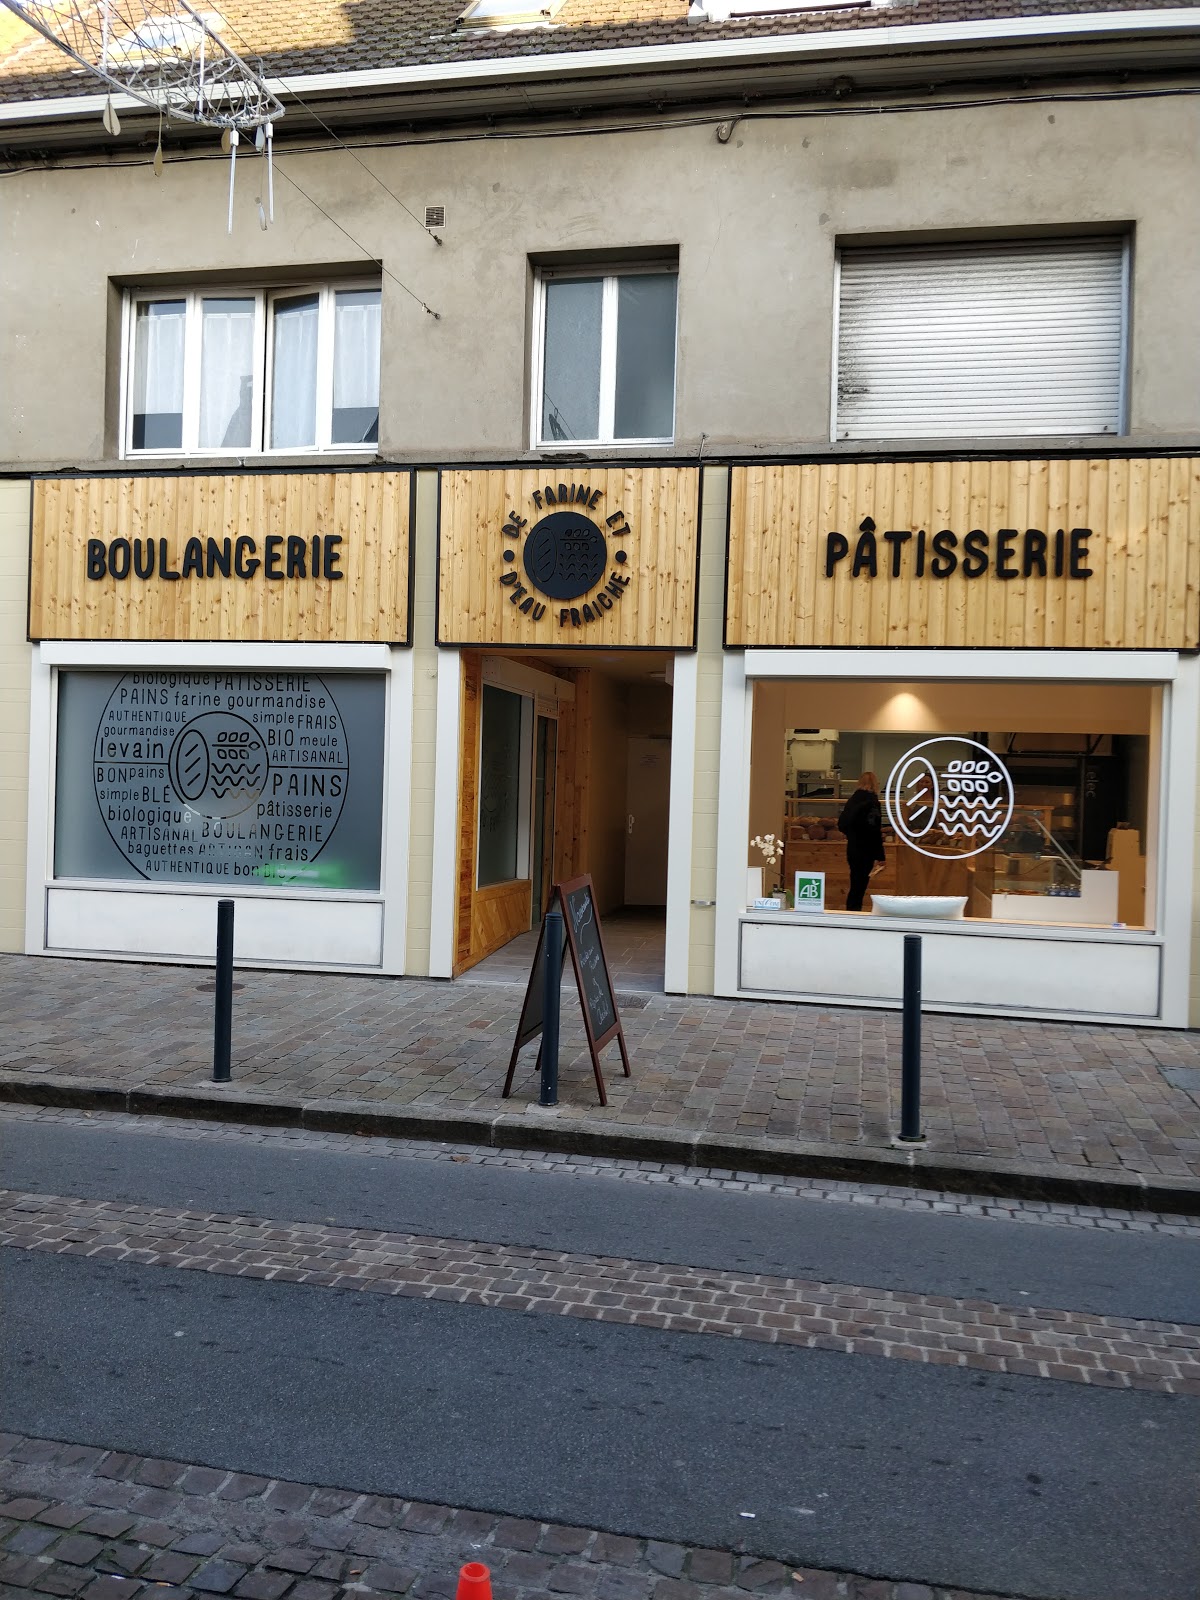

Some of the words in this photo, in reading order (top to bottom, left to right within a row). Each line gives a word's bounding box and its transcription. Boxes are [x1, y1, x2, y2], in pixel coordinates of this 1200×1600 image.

[501, 510, 528, 539] DE
[532, 483, 603, 510] FARINE
[605, 510, 631, 536] ET
[826, 516, 1093, 578] PÂTISSERIE
[87, 535, 344, 580] BOULANGERIE
[500, 571, 547, 621] D'EAU
[559, 571, 631, 628] FRAICHE
[120, 688, 168, 705] PAINS
[174, 691, 221, 706] farine
[228, 694, 326, 710] gourmandise
[108, 710, 187, 723] AUTHENTIQUE
[252, 711, 294, 725] simple
[297, 714, 337, 729] FRAIS
[104, 726, 175, 737] gourmandise
[268, 729, 294, 746] BIO
[300, 735, 338, 746] meule
[100, 737, 164, 758] levain
[272, 749, 343, 764] ARTISANAL
[97, 767, 127, 783] BON
[129, 765, 165, 780] pains
[100, 788, 139, 802] simple
[142, 785, 171, 803] BLÉ
[272, 773, 342, 797] PAINS
[108, 805, 192, 826] biologique
[256, 800, 333, 819] pâtisserie
[120, 826, 199, 843] ARTISANAL
[201, 821, 323, 842] BOULANGERIE
[128, 841, 194, 857] baguettes
[269, 843, 308, 861] frais
[145, 859, 230, 875] AUTHENTIQUE
[799, 883, 819, 898] AB
